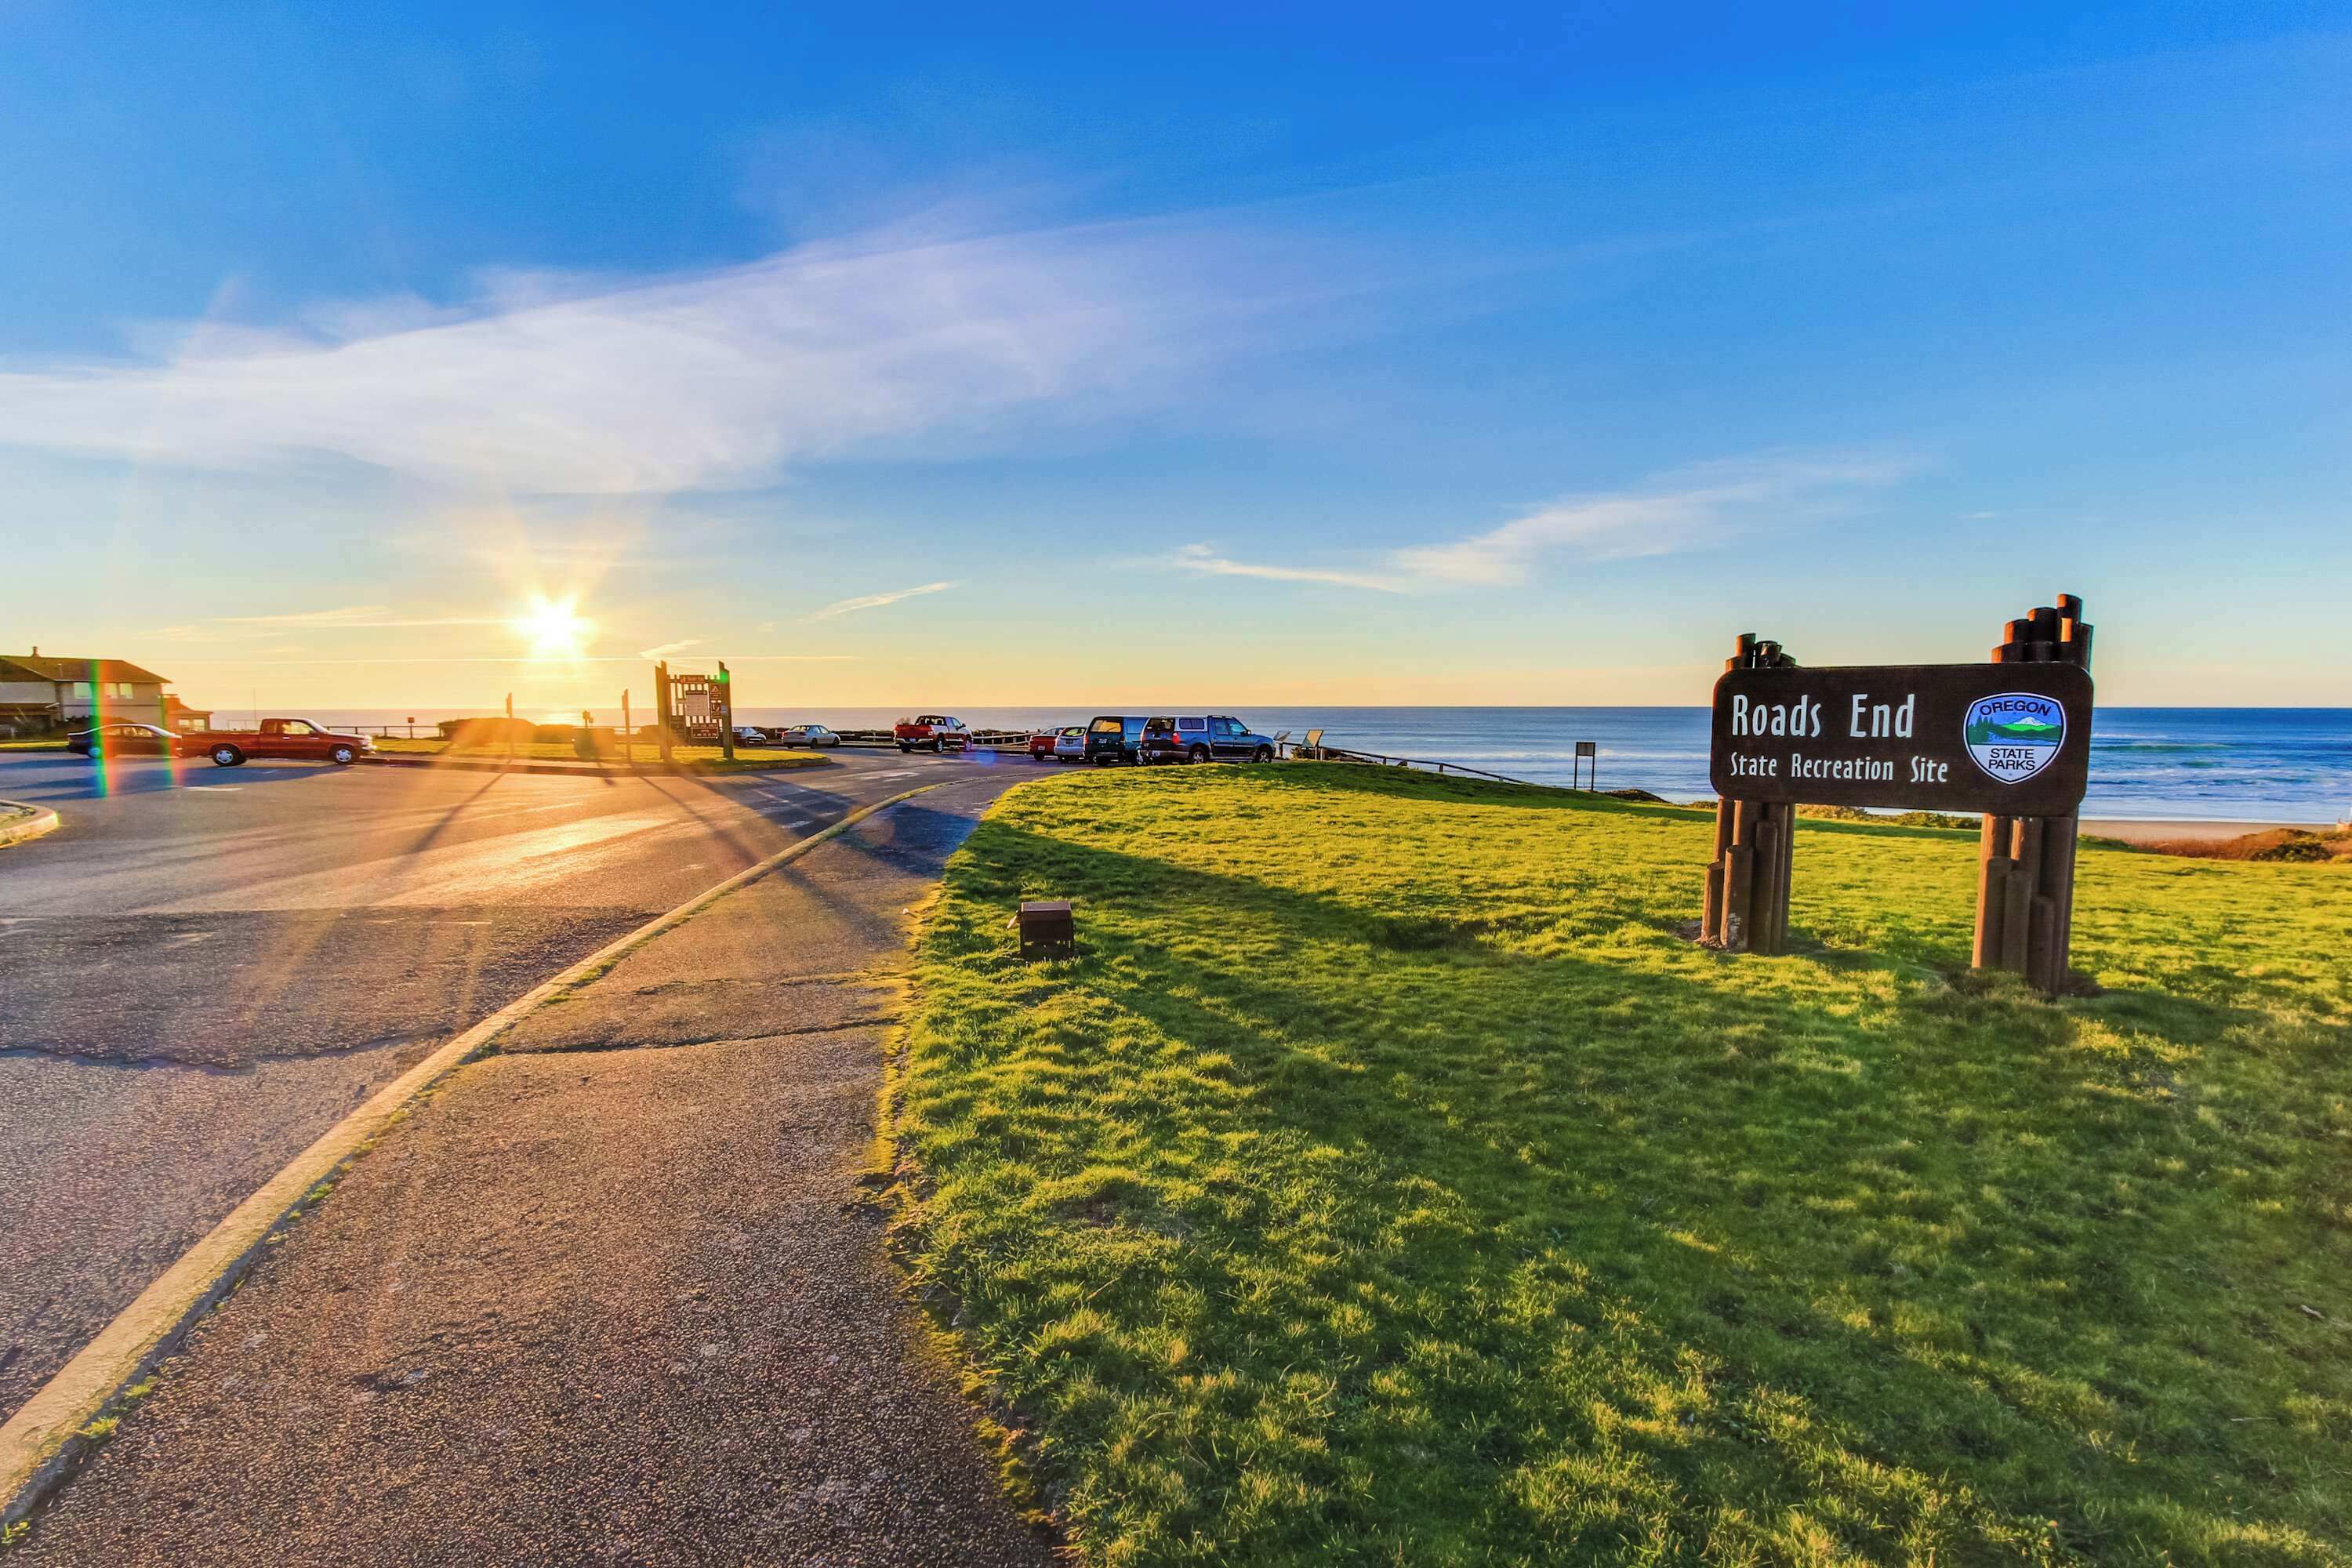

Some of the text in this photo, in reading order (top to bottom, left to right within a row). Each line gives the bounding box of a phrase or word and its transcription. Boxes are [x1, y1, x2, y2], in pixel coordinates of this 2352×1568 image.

[1732, 693, 1915, 738] Roads End
[1980, 700, 2052, 716] OREGON
[1990, 748, 2034, 759] STATE
[1730, 751, 1948, 782] State Recreation Site
[1988, 759, 2036, 771] PARKS
